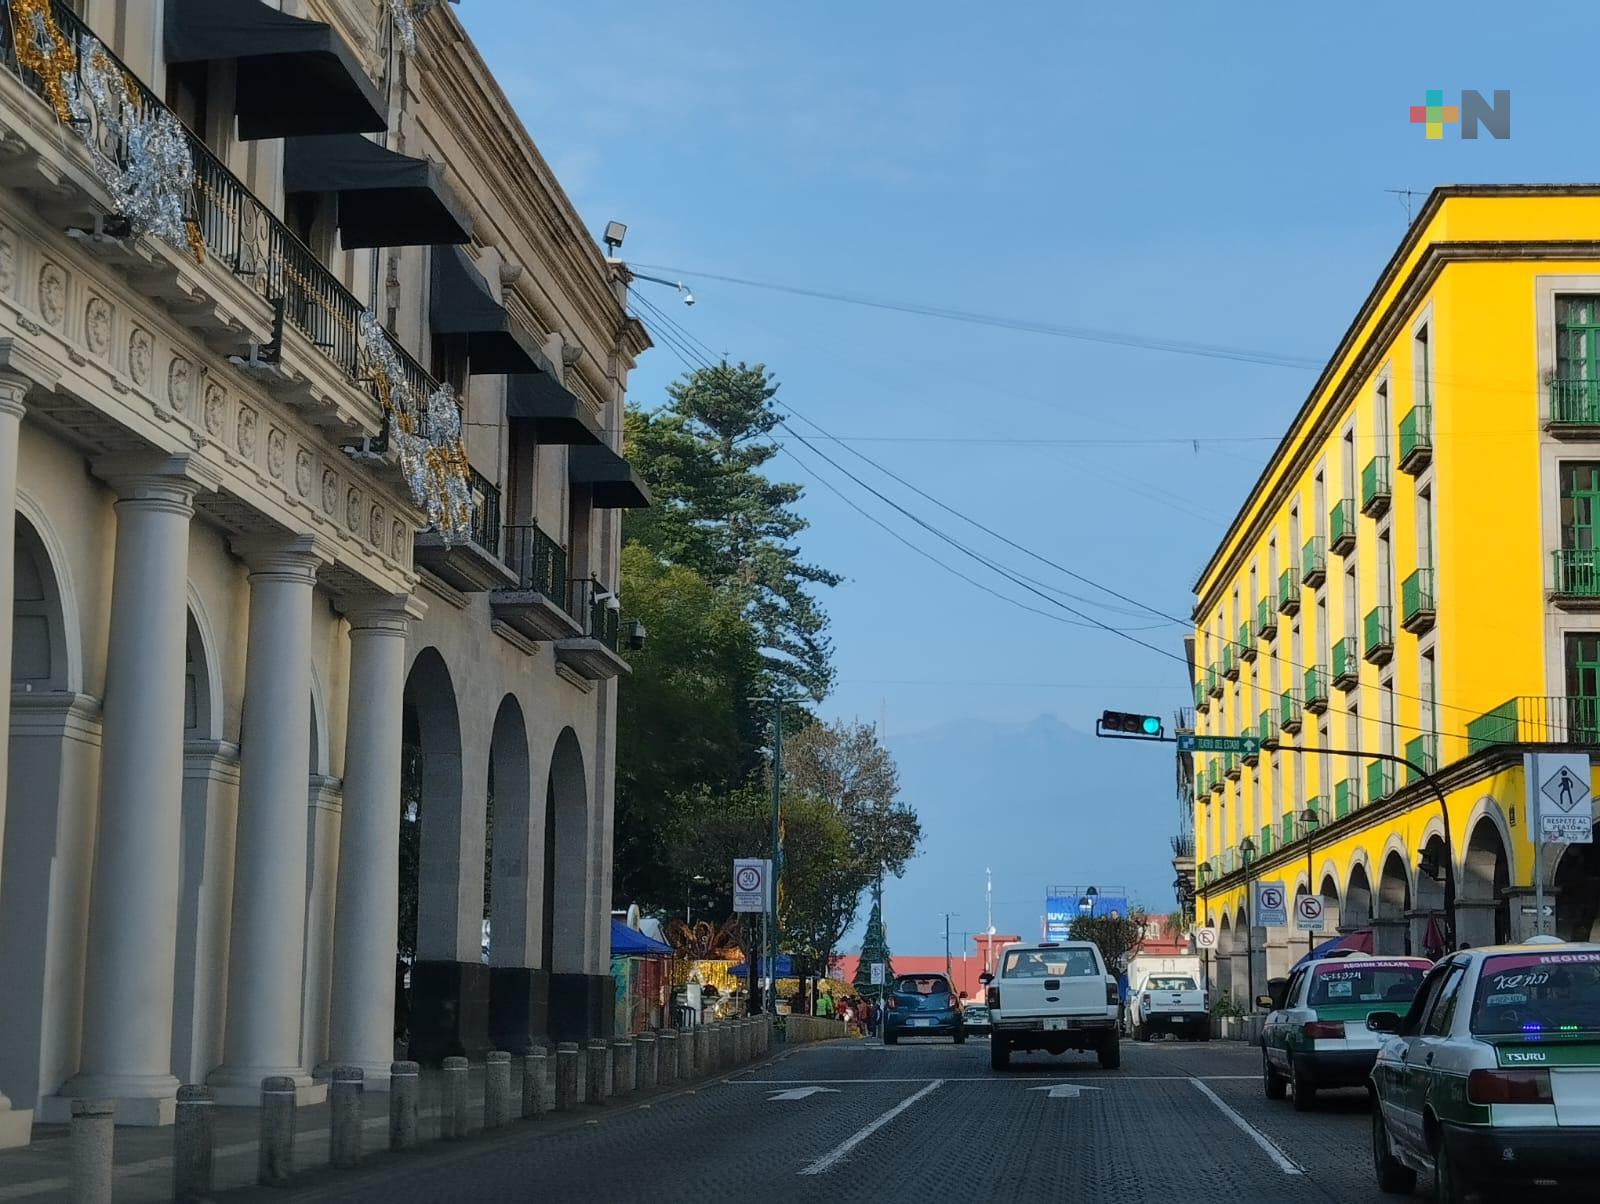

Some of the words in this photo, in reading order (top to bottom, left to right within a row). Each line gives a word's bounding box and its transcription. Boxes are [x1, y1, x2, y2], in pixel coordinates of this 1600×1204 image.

[743, 872, 754, 882] 30
[1540, 954, 1600, 964] REGION
[1506, 1053, 1546, 1061] TSURU
